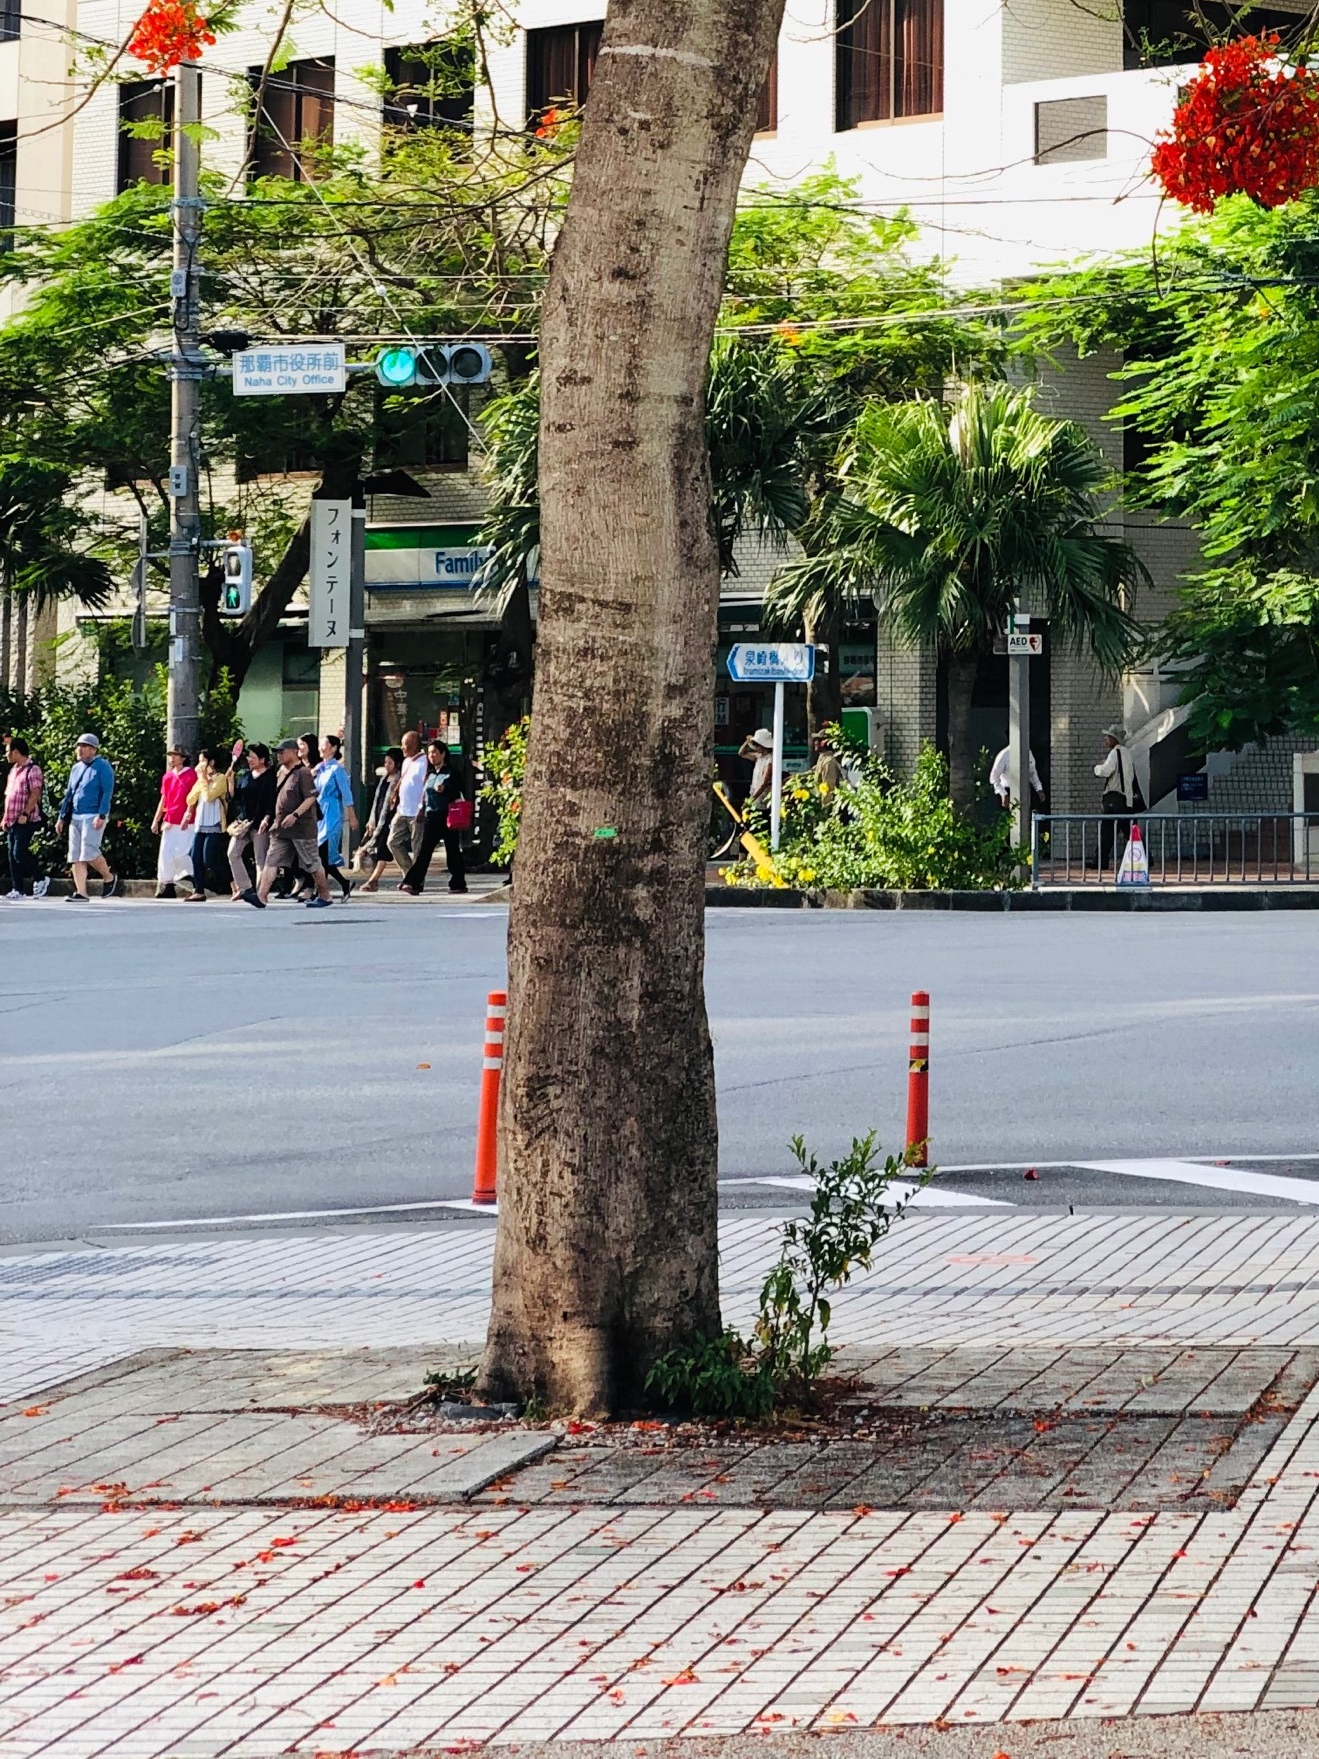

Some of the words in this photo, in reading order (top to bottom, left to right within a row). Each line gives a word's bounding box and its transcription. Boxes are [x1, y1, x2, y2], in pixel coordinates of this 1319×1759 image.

[240, 352, 339, 373] 那覇市役所前
[244, 377, 272, 387] Naha
[276, 375, 297, 387] City
[302, 374, 335, 385] Office
[325, 507, 341, 638] フォンテーヌ
[435, 550, 491, 574] Family
[1010, 636, 1028, 646] AED
